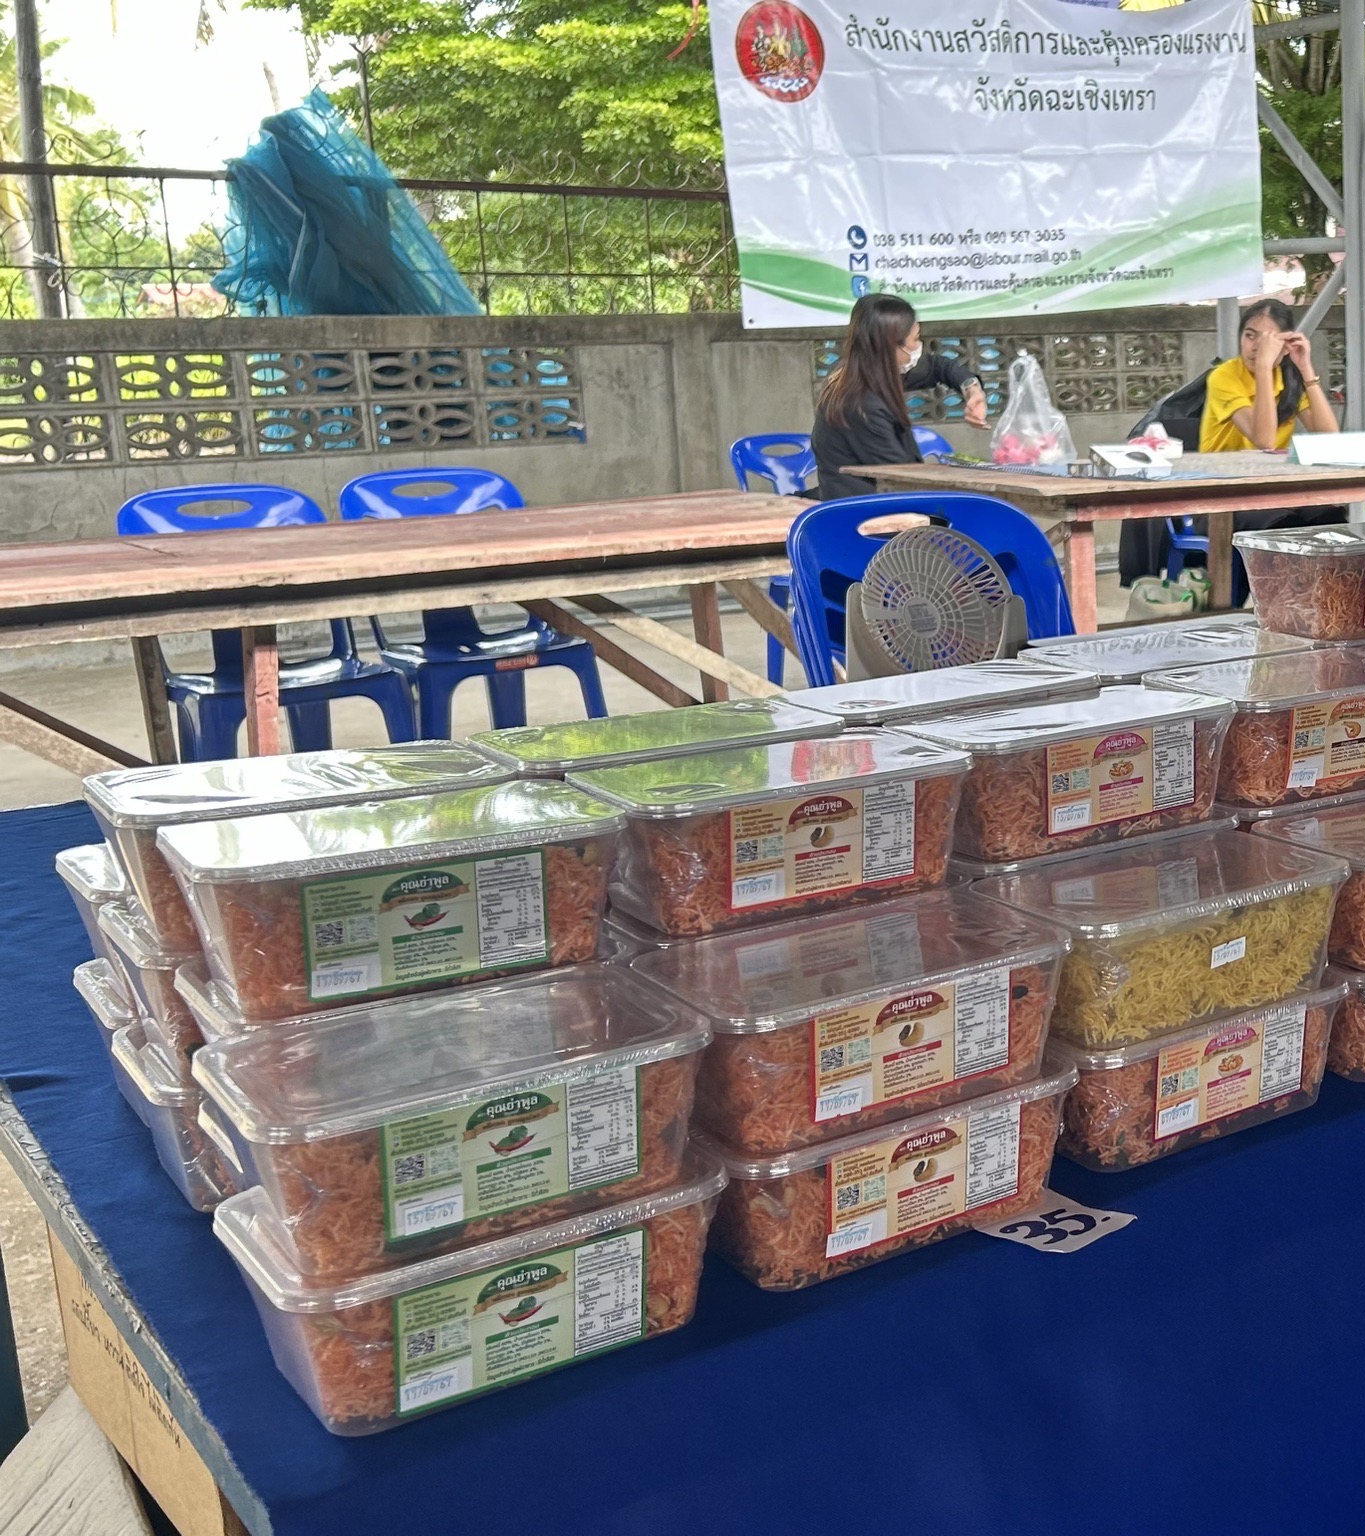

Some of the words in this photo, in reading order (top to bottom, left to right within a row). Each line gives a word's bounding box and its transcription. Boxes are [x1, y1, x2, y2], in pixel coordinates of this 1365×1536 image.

[845, 14, 1248, 66] สำนักงานสวัสดิการและคุ้มครองแรงงาน
[974, 76, 1156, 112] จังหวัดฉะเชิงเทรา
[900, 233, 923, 246] 511
[929, 232, 954, 246] 600
[959, 228, 981, 245] หรือ
[1035, 229, 1066, 242] 3035
[400, 874, 449, 893] คุณย่าพูล
[891, 993, 933, 1014] คุณย่าพูล
[486, 1093, 539, 1117] คุณย่าพูล
[905, 1128, 947, 1151] คุณย่าพูล
[497, 1266, 548, 1291] คุณย่าพูล
